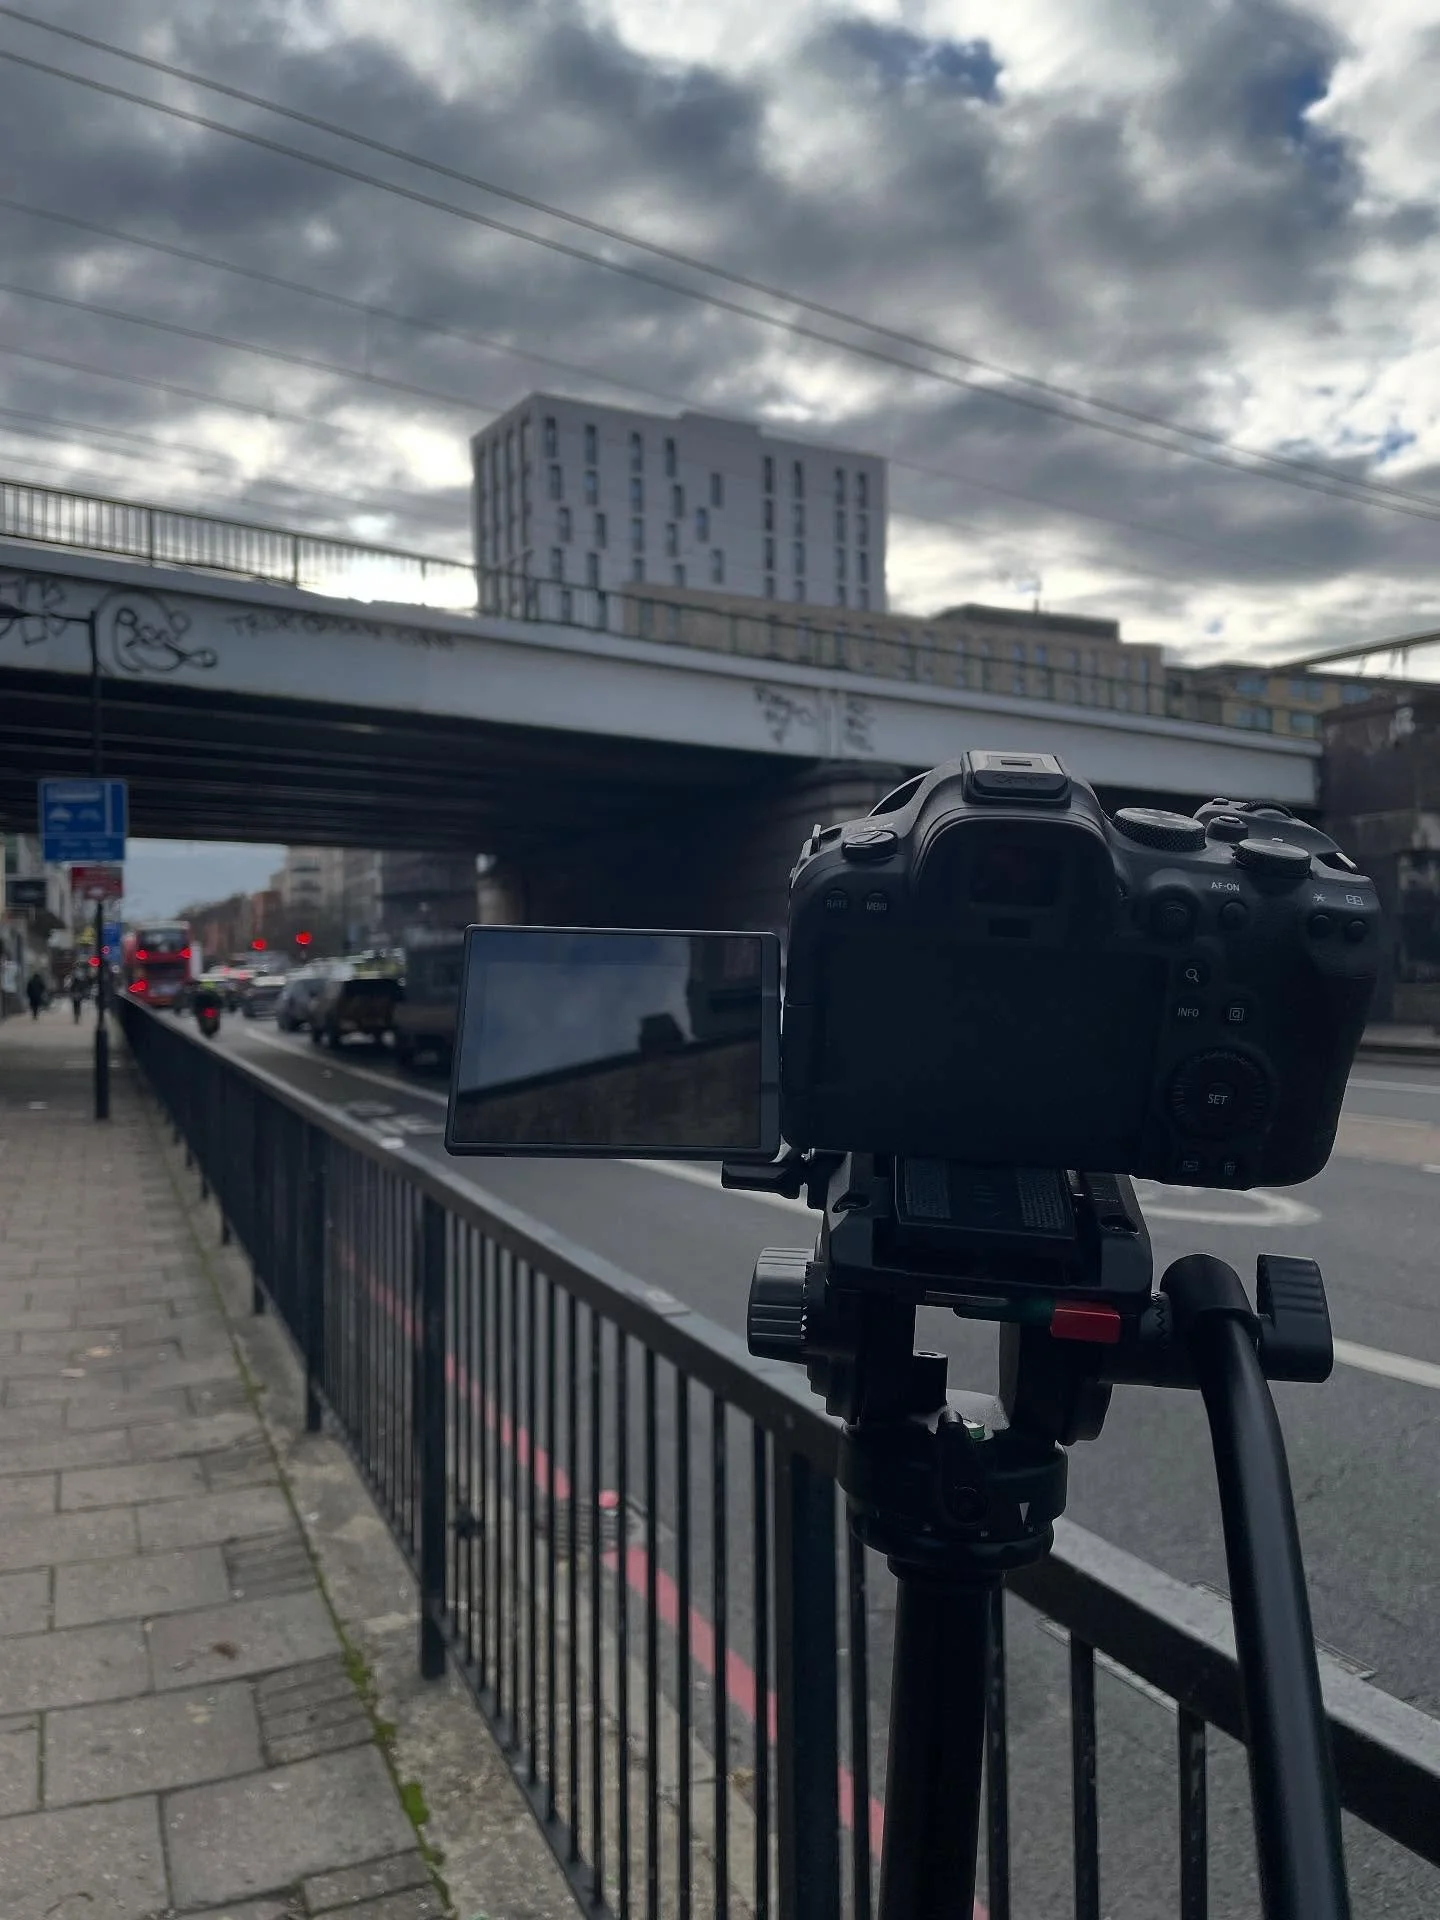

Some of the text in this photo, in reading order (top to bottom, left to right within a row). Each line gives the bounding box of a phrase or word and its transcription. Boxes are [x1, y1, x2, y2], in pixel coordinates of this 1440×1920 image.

[1211, 881, 1240, 892] AF-ON
[1177, 1007, 1200, 1018] INFO
[1207, 1093, 1229, 1105] SET
